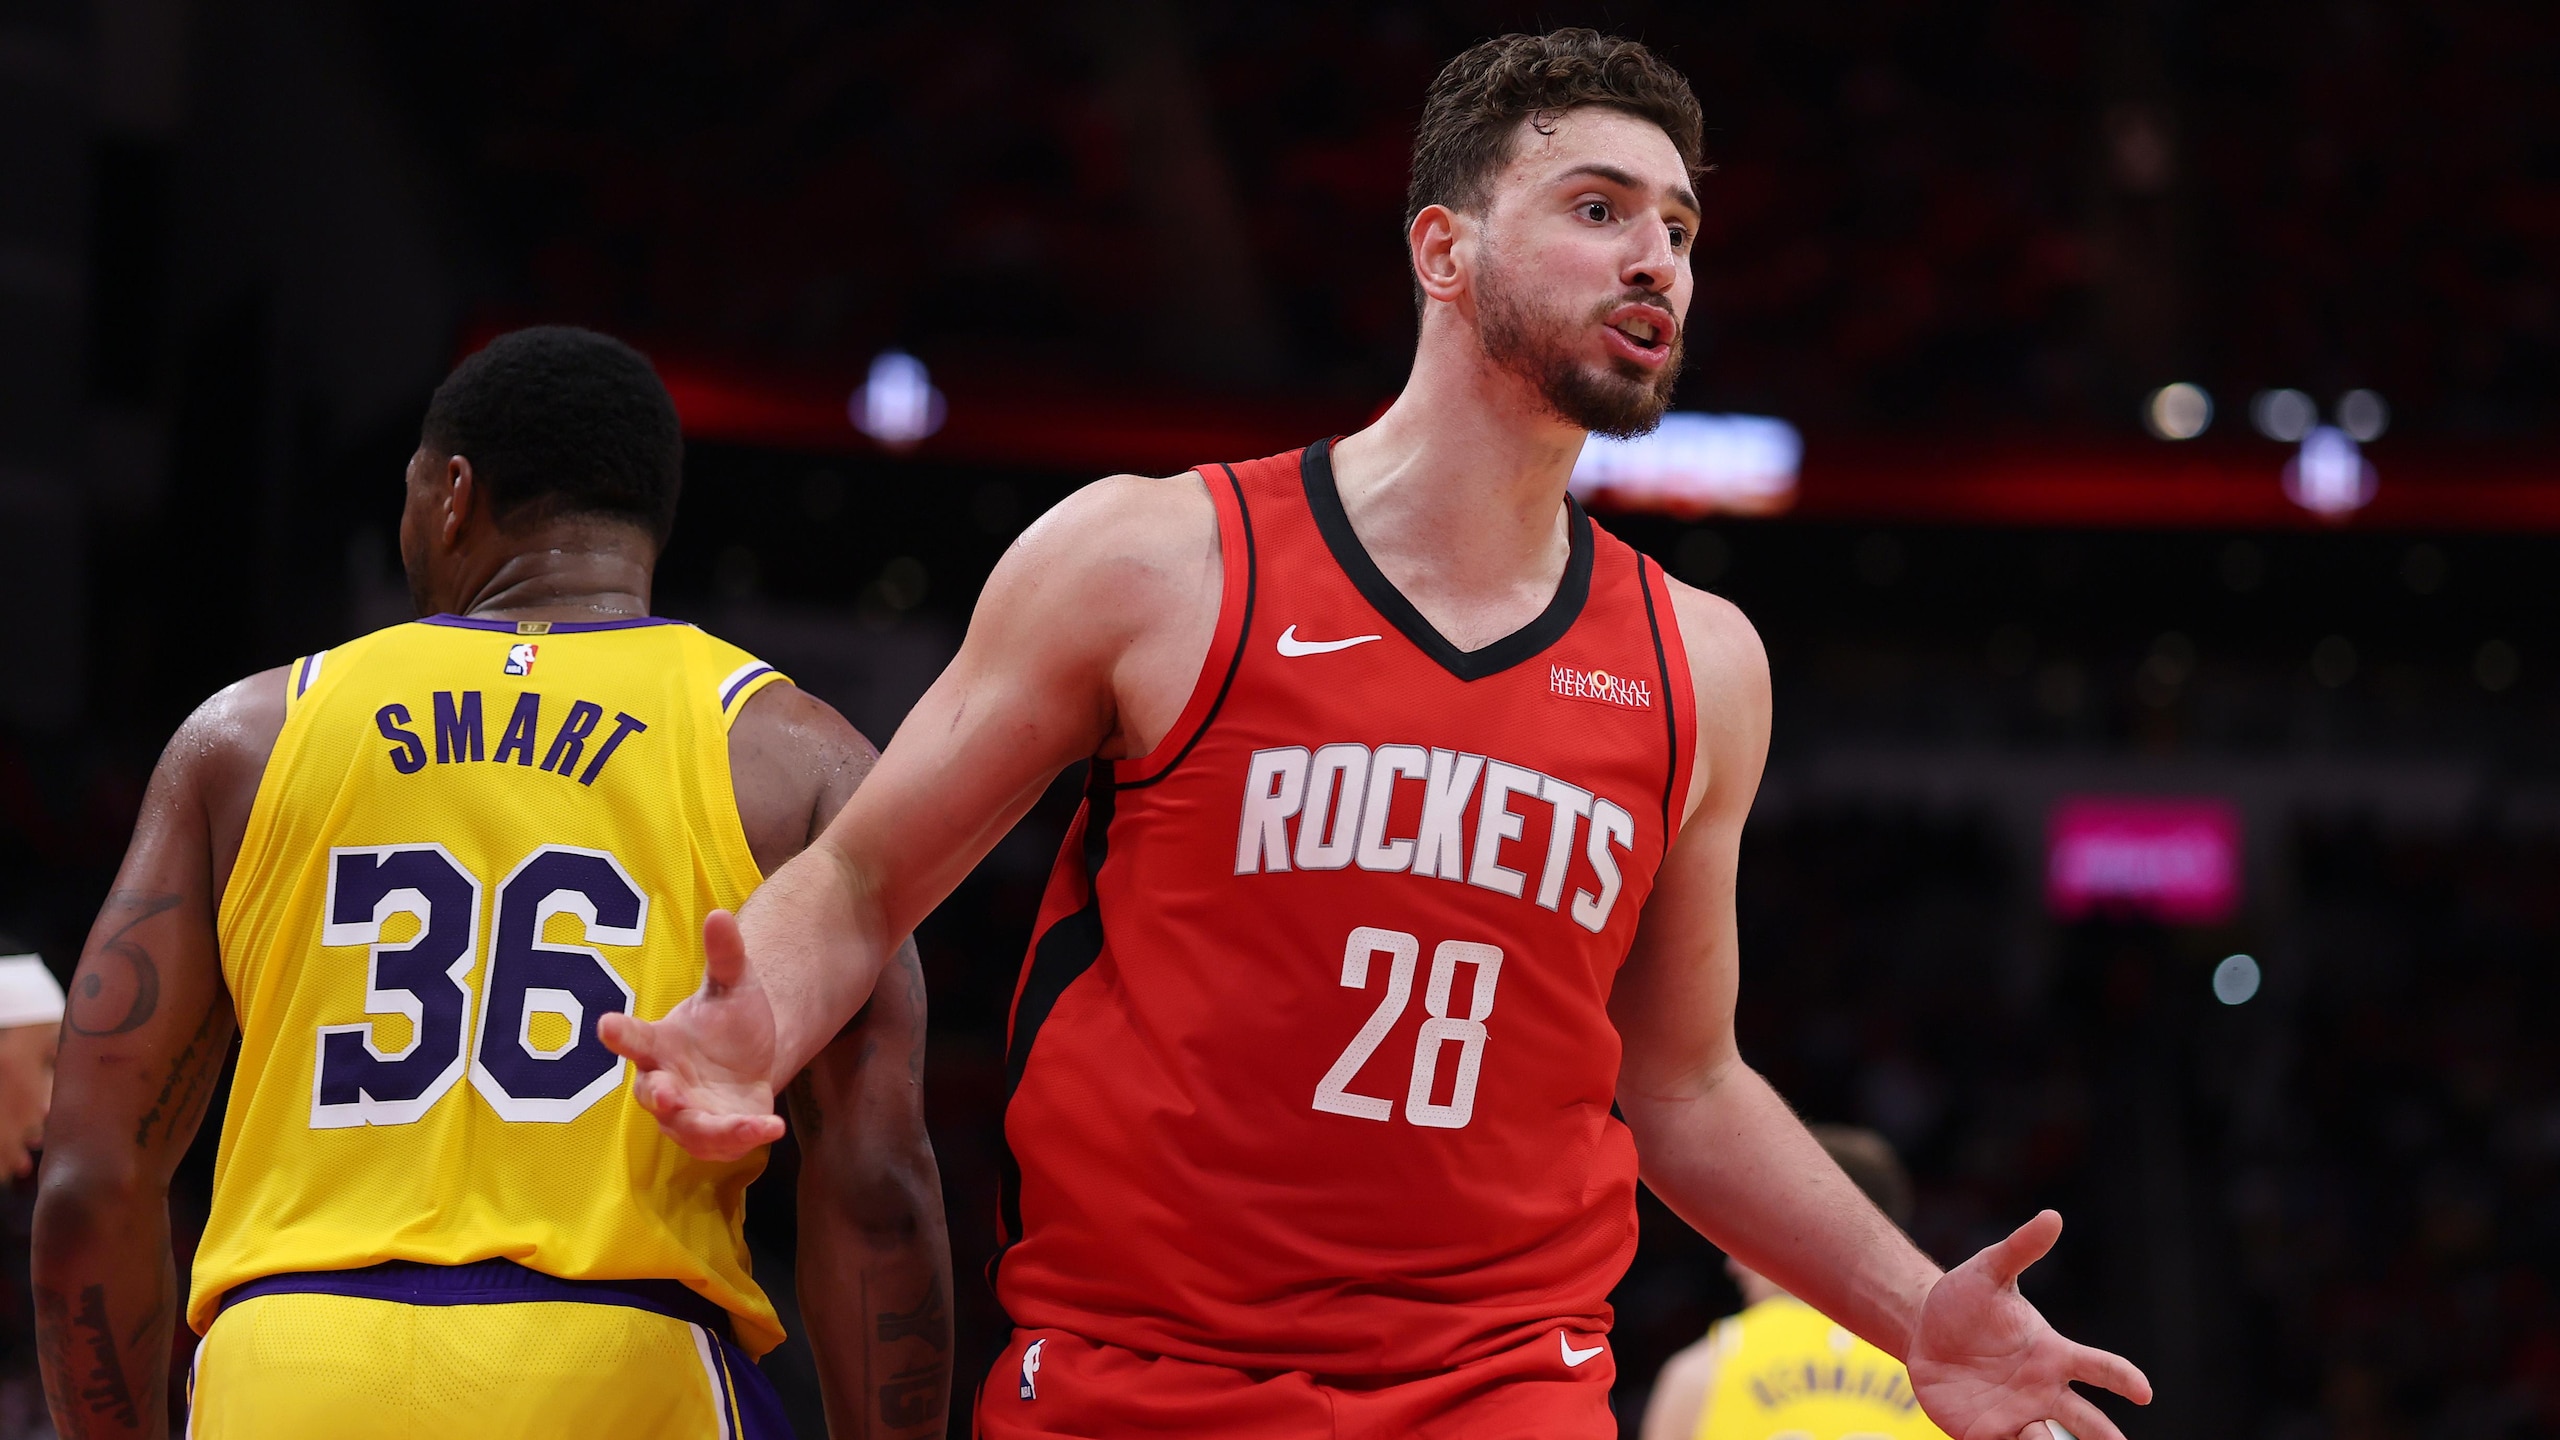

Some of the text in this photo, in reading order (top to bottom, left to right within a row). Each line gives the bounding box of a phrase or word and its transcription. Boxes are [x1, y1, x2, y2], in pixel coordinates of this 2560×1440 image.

[374, 690, 648, 787] SMART
[1550, 663, 1651, 695] MEMORIAL
[1550, 676, 1651, 707] HERMANN
[1234, 742, 1635, 934] ROCKETS
[309, 842, 649, 1129] 36
[1311, 926, 1504, 1129] 28
